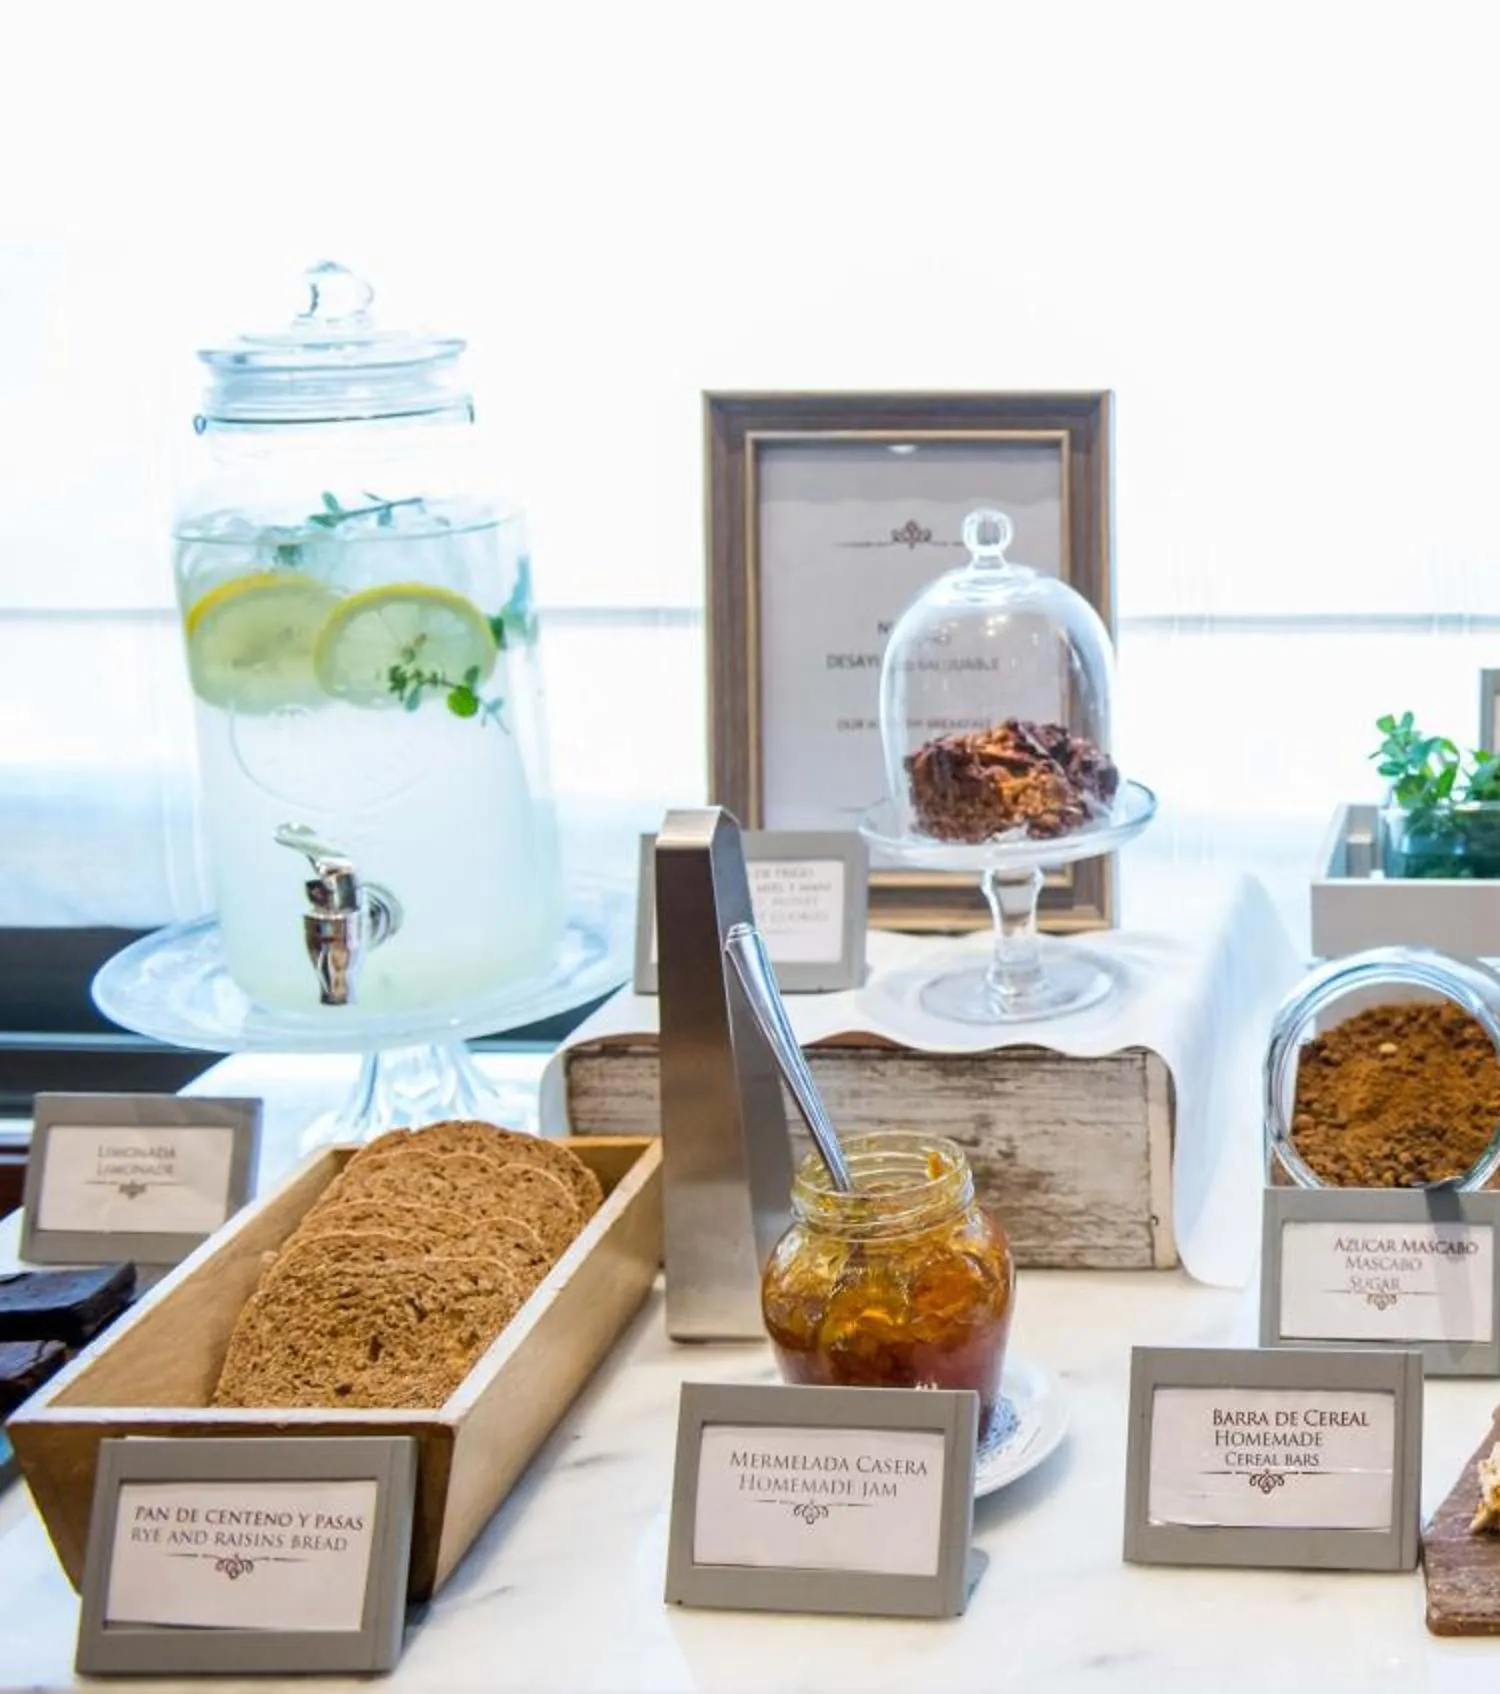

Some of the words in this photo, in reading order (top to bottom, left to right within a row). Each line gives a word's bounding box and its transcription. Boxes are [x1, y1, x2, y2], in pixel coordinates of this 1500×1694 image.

[1334, 1238, 1395, 1253] AZUCAR
[1401, 1239, 1479, 1255] MASCABO
[1345, 1256, 1422, 1271] MASCABO
[1350, 1275, 1400, 1291] SUGAR
[1212, 1408, 1269, 1426] BARRA
[1275, 1411, 1299, 1426] DE
[1303, 1409, 1369, 1427] CEREAL
[1215, 1430, 1323, 1447] HOMEMADE
[730, 1451, 850, 1473] MERMELADA
[856, 1455, 928, 1477] CASERA
[1225, 1451, 1279, 1467] CEREAL
[1285, 1453, 1320, 1467] BARS
[739, 1472, 852, 1496] HOMEMADE
[862, 1482, 898, 1498] JAM
[135, 1505, 170, 1522] PAN
[176, 1507, 198, 1524] DE
[205, 1509, 293, 1528] CENTENO
[298, 1513, 312, 1530] Y
[315, 1516, 364, 1531] PASAS
[131, 1526, 161, 1543] RYE
[167, 1528, 209, 1546] AND
[214, 1532, 285, 1548] RAISINS
[291, 1535, 347, 1551] BREAD
